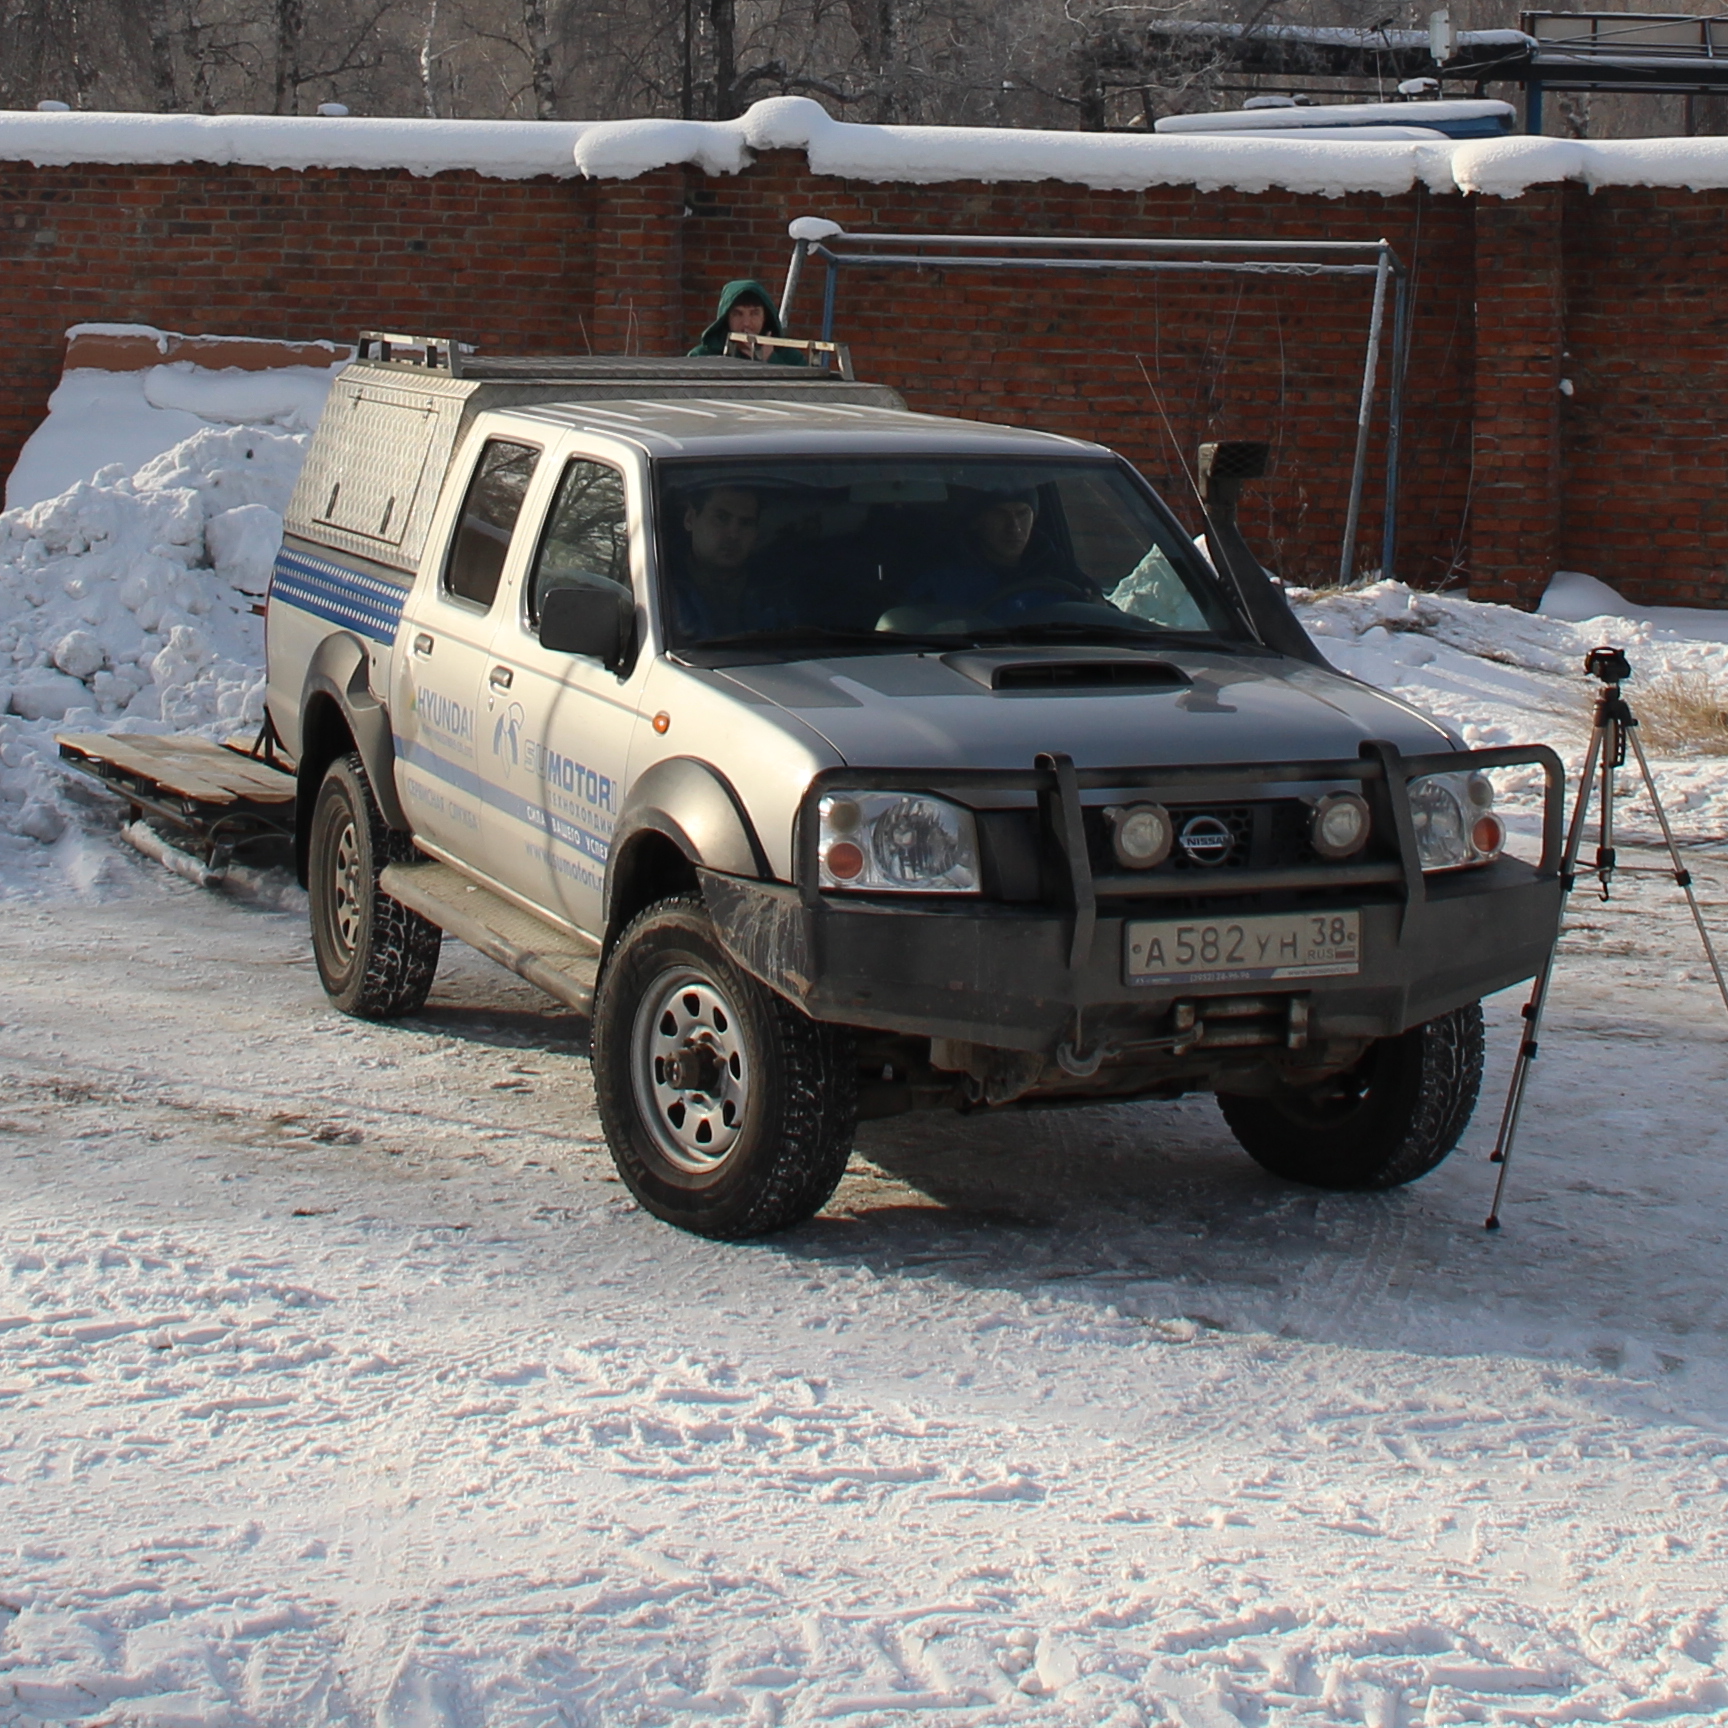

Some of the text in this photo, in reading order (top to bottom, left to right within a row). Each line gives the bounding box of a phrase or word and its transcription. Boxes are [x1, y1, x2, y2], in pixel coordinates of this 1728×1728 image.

[417, 685, 474, 743] HYUNDAI
[525, 739, 617, 816] SUMOTORI
[526, 805, 547, 827] СИЛА
[551, 817, 581, 845] ВАШЕГО
[547, 790, 615, 835] ТЕХНОХОЛДИН
[524, 842, 603, 893] www.sumotori.r
[1307, 948, 1334, 960] RUS
[1310, 917, 1345, 946] 38
